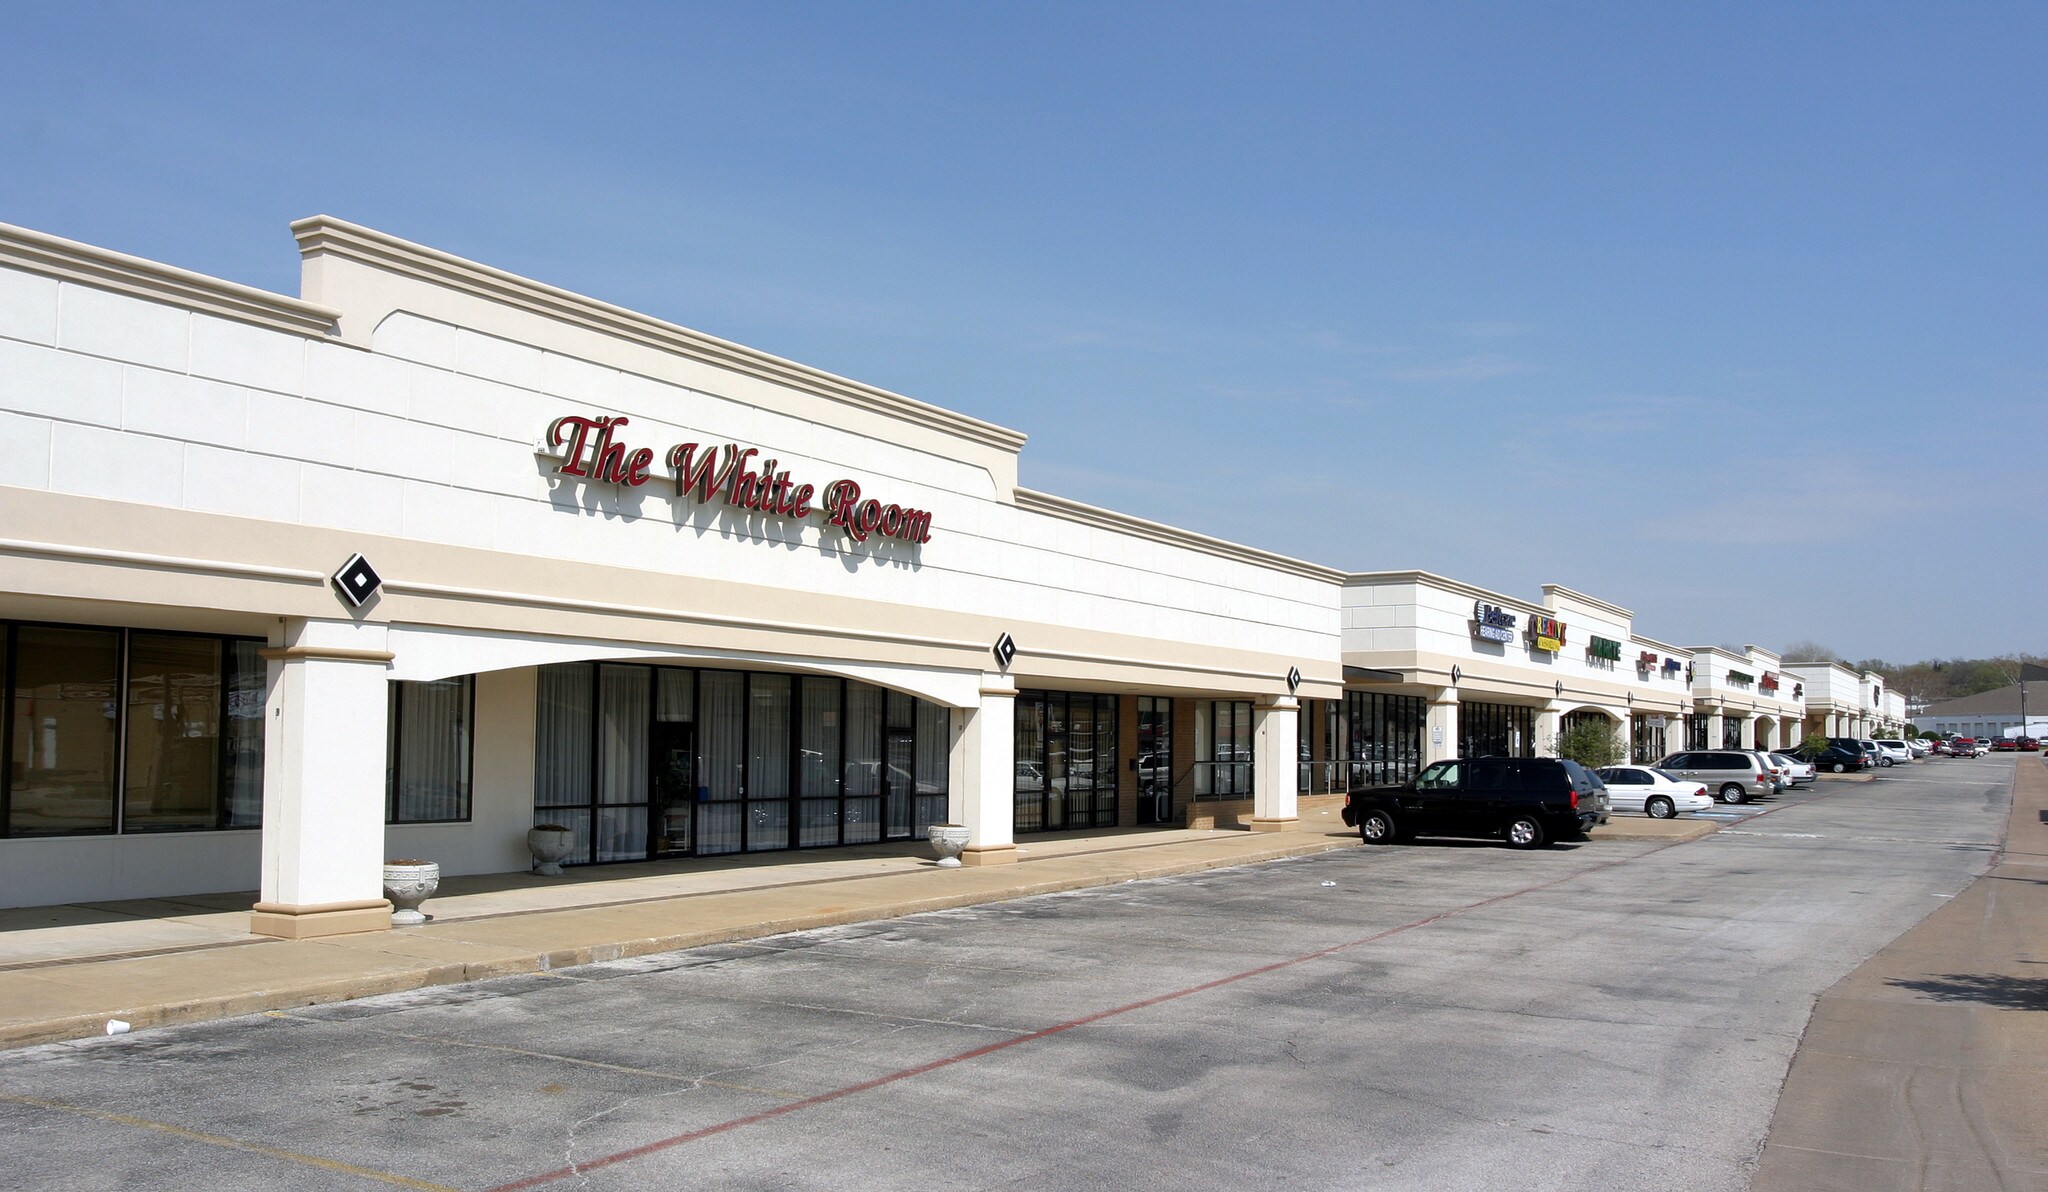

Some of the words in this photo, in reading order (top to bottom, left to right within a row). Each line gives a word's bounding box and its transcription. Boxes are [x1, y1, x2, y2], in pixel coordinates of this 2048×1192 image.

[547, 416, 653, 487] The
[666, 443, 815, 519] White
[822, 479, 932, 544] Room
[1528, 614, 1567, 646] CREATIVE
